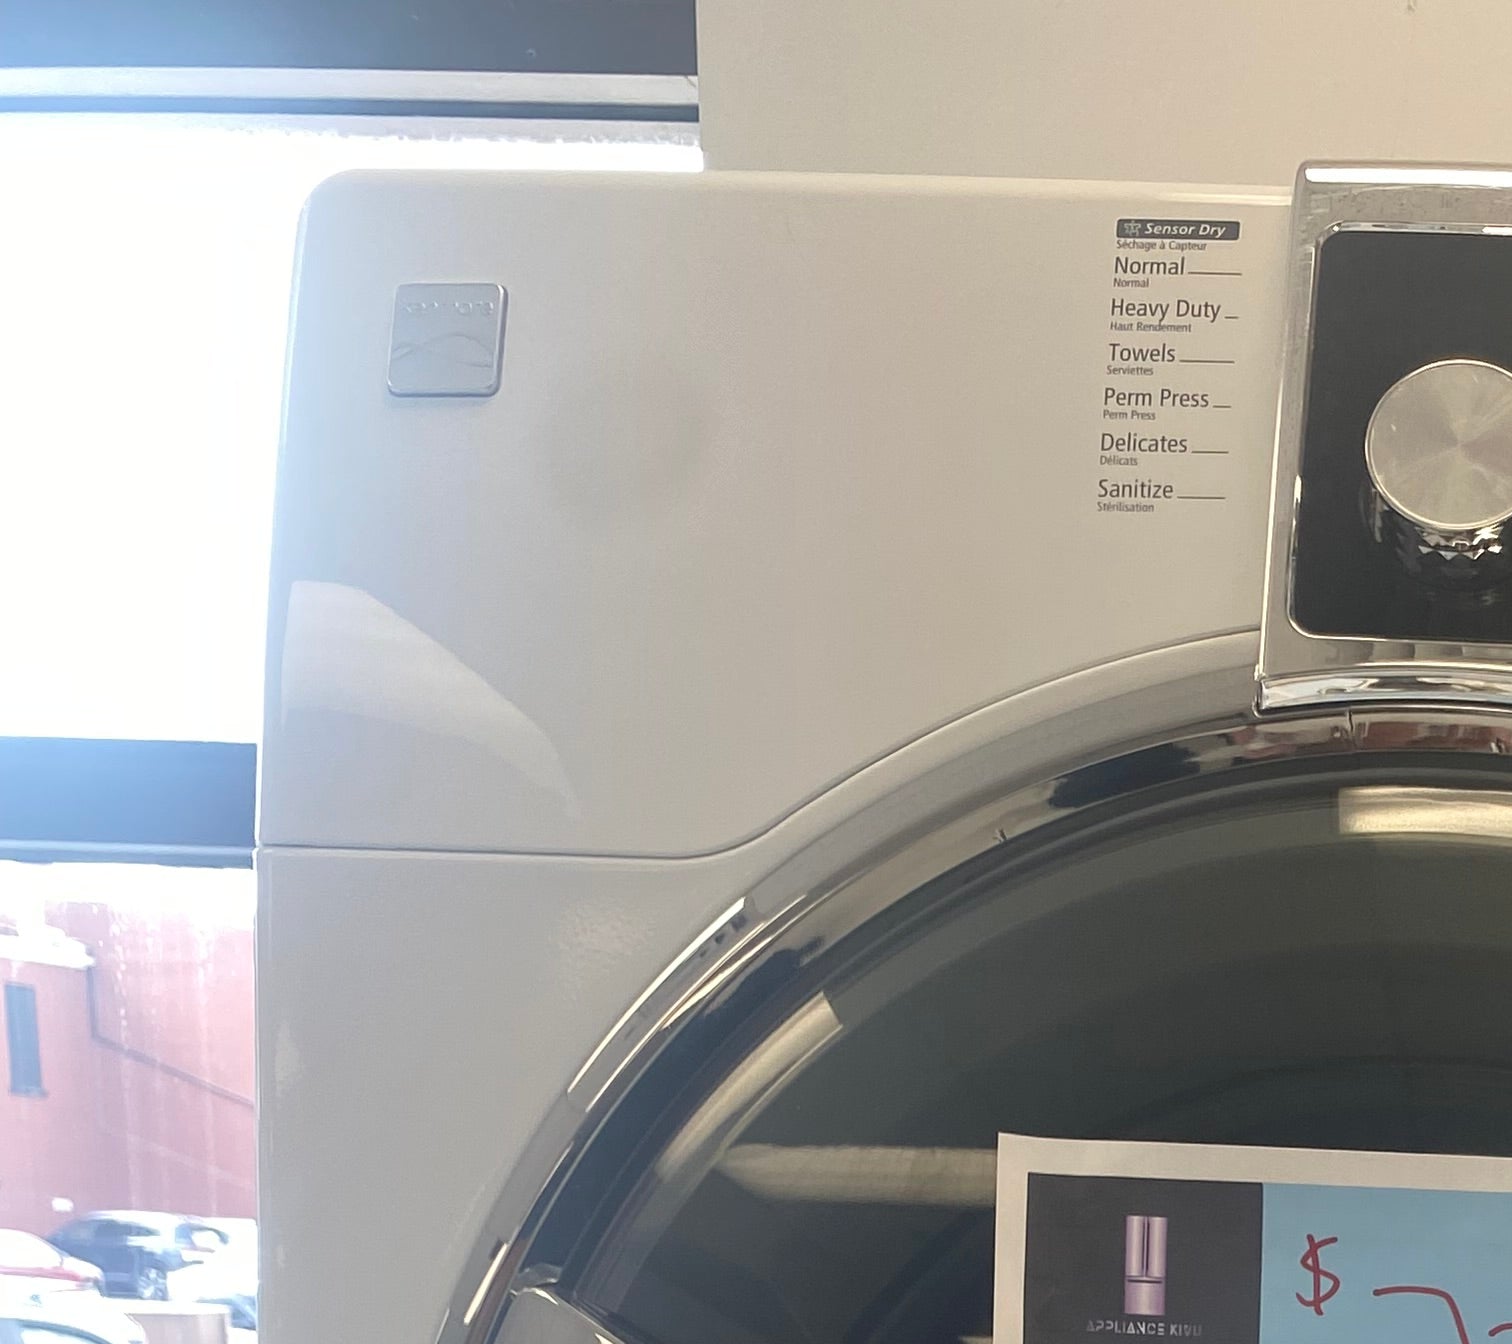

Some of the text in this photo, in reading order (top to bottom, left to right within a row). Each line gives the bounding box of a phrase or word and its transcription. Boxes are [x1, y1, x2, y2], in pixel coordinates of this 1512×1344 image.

[1144, 223, 1226, 238] Sensor Dry
[1115, 257, 1185, 275] Normal
[1114, 278, 1149, 288] Normal
[1111, 298, 1221, 322] Heavy Duty
[1109, 344, 1175, 362] Towels
[1104, 388, 1209, 408] Perm Press
[1101, 433, 1187, 453] Delicates
[1098, 479, 1173, 499] Sanitize
[1086, 1320, 1201, 1336] APPLIANCE KIVU
